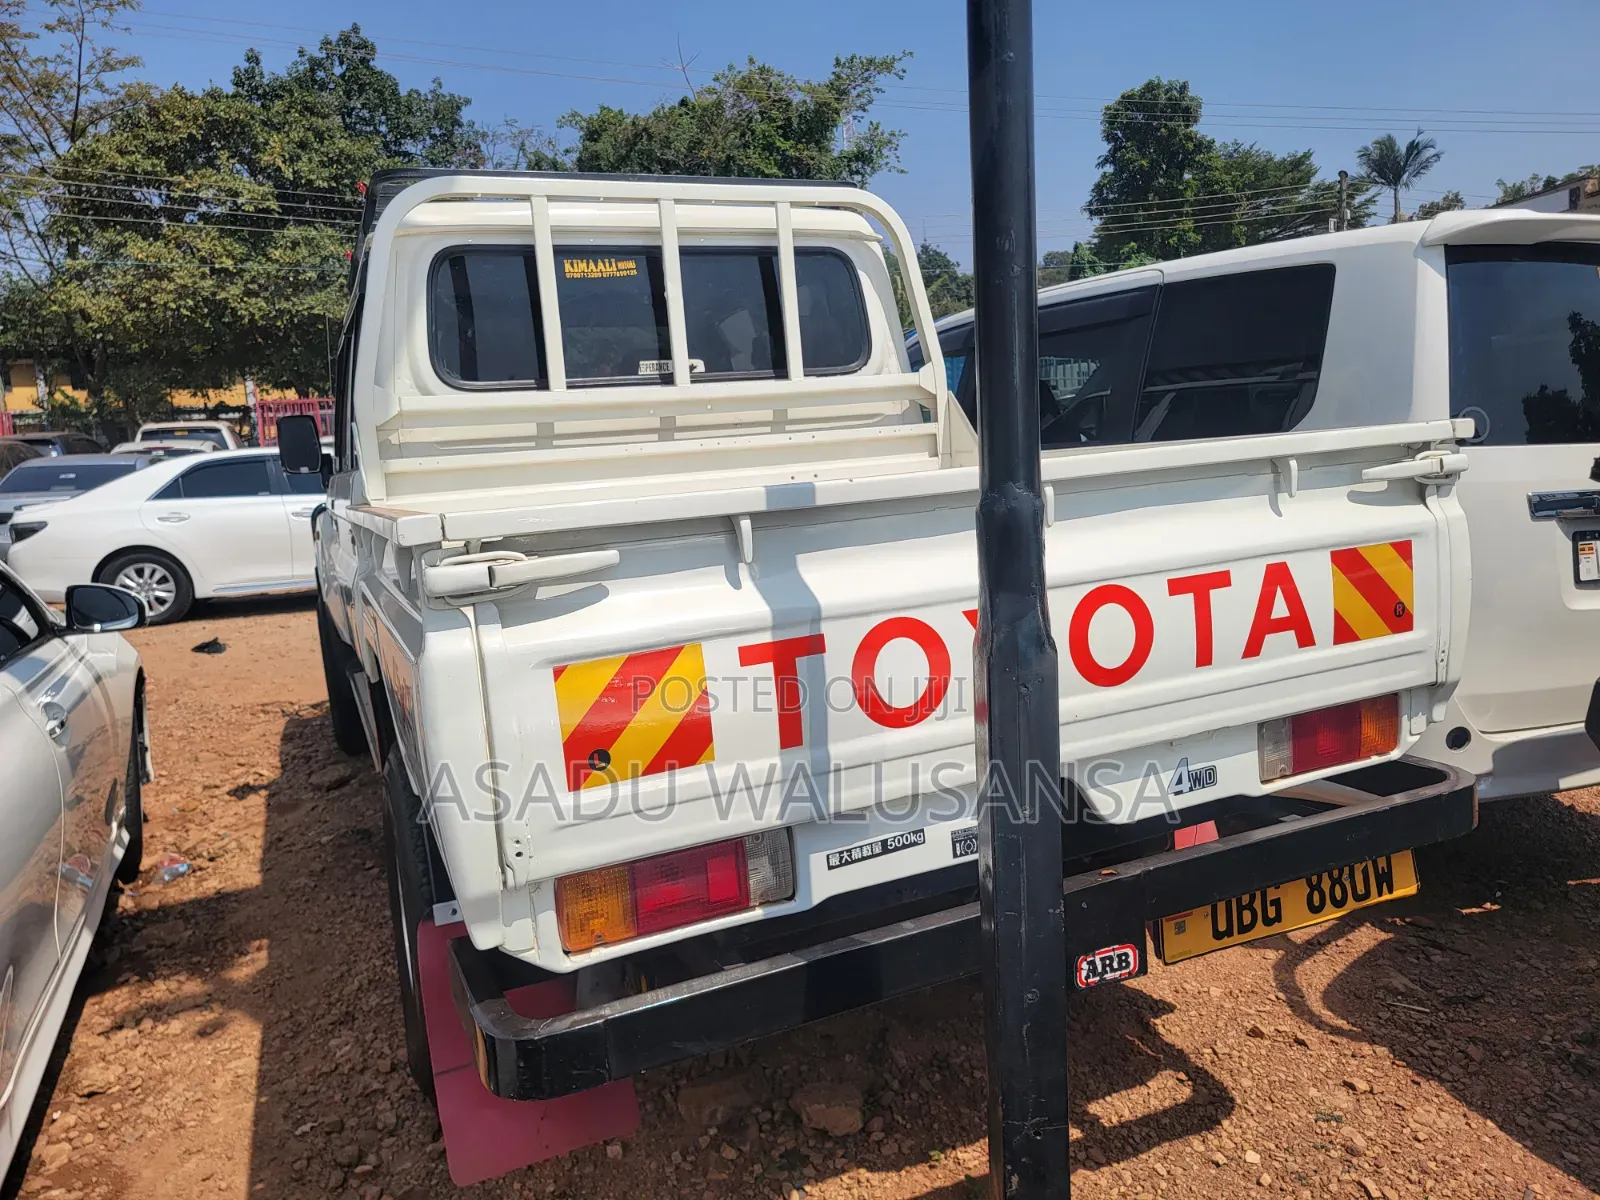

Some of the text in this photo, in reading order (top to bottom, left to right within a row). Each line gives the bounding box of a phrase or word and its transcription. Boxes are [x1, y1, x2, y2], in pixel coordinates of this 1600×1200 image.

[563, 258, 617, 272] KIMAALI
[639, 362, 670, 373] ESPERANCE
[738, 561, 1316, 749] TOOTA
[1167, 757, 1217, 795] 4WD
[887, 832, 925, 850] 500kg
[1210, 886, 1283, 941] UBG
[1084, 951, 1131, 980] ARB
